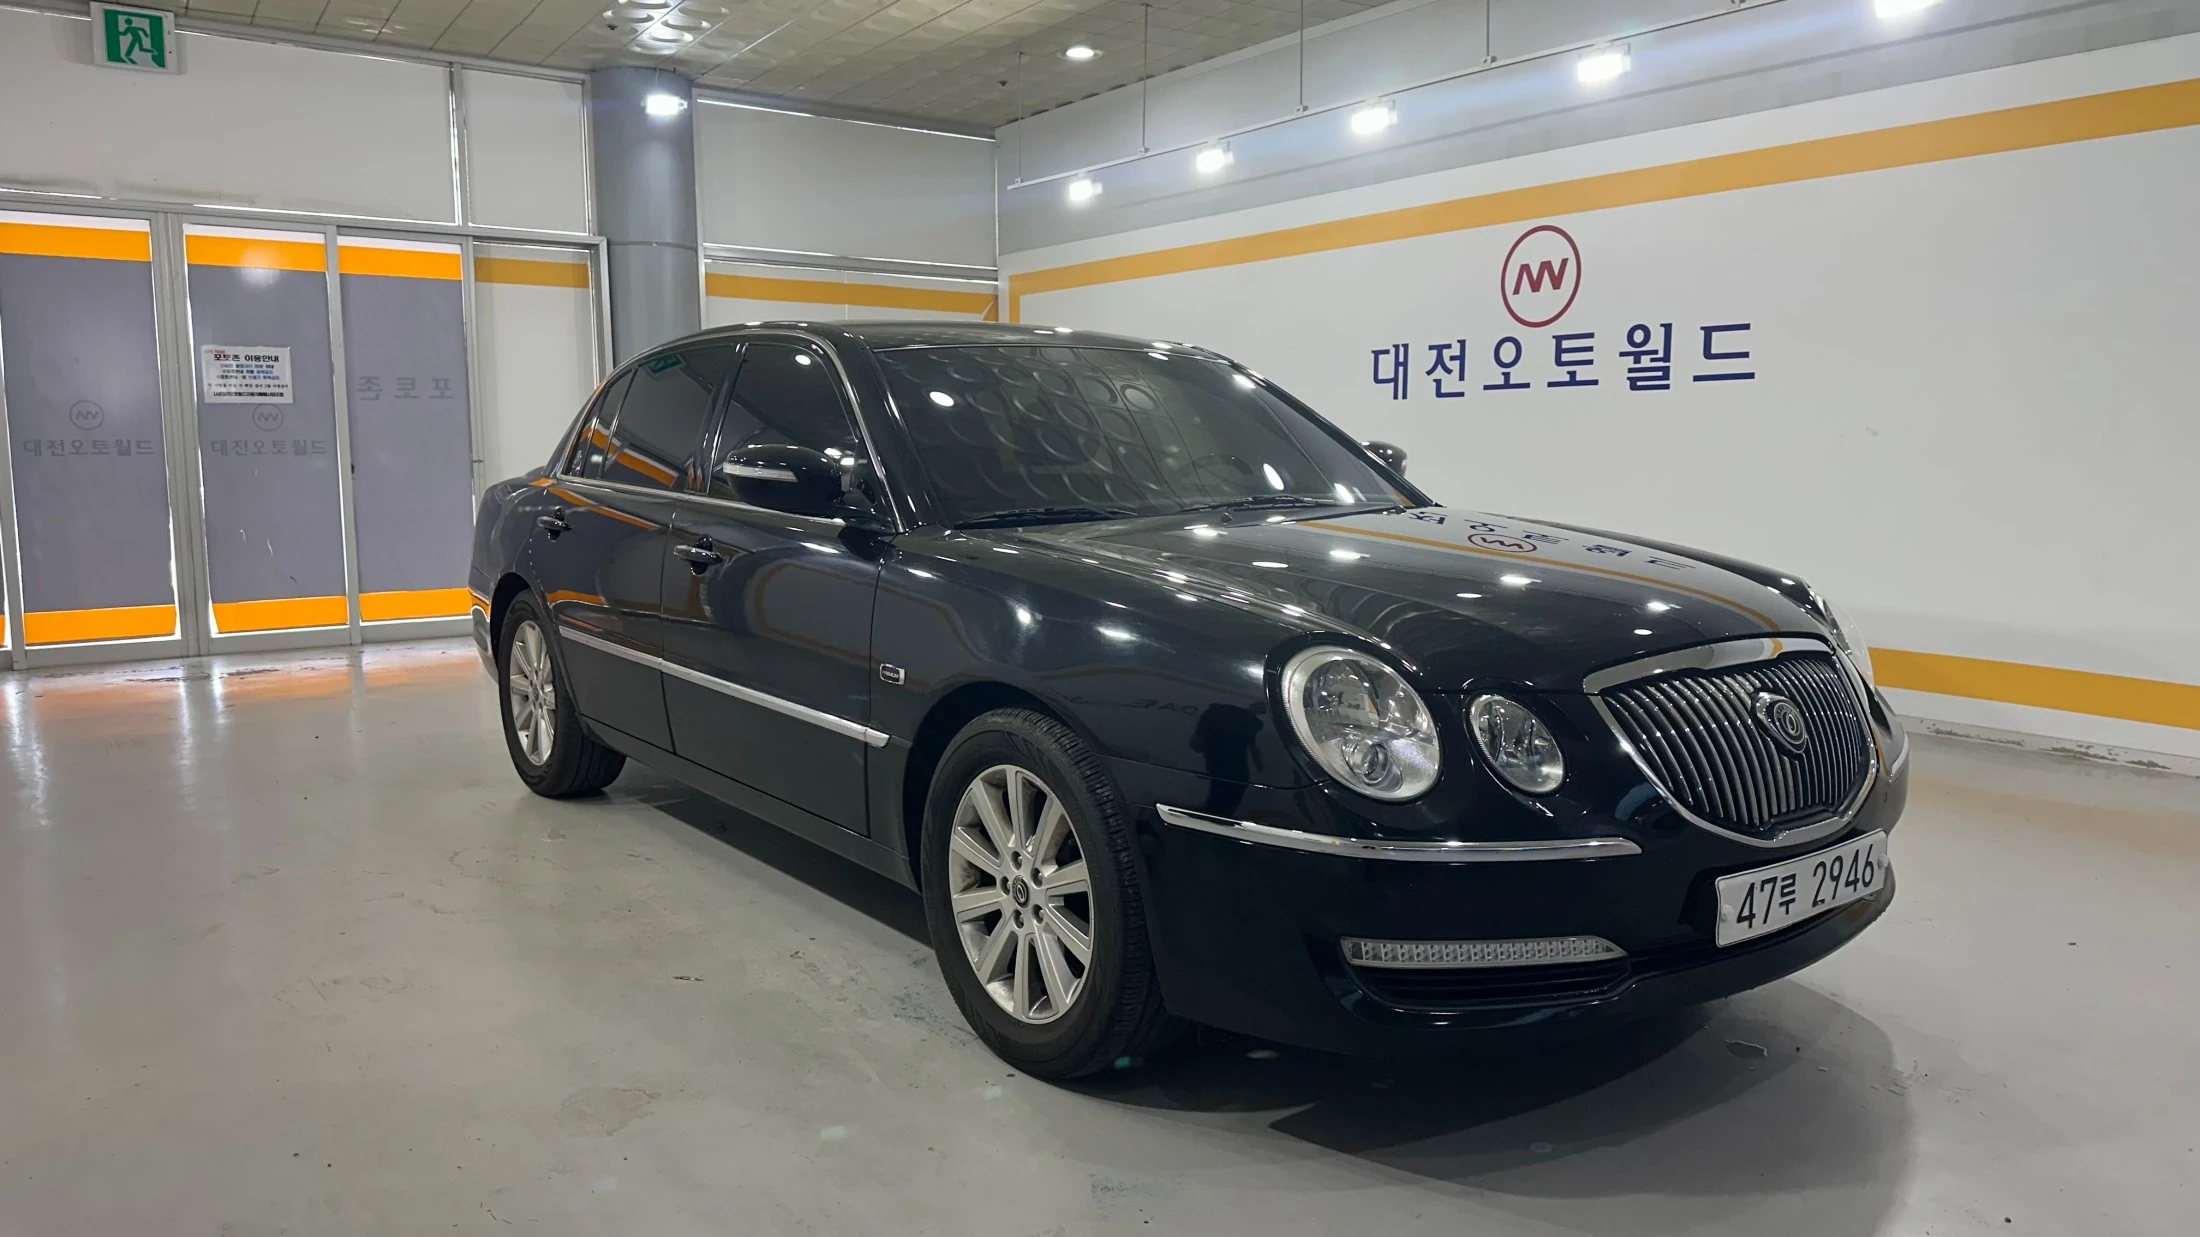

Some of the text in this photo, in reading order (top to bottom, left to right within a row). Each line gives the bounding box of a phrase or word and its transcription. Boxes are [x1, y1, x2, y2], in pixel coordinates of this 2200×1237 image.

[213, 353, 279, 363] 포토존 이용안내
[1370, 322, 1756, 400] 대전오토월드
[22, 438, 155, 457] 대전오토월드
[210, 438, 328, 457] 대전오토월드
[1735, 843, 1875, 930] 47루 2946
